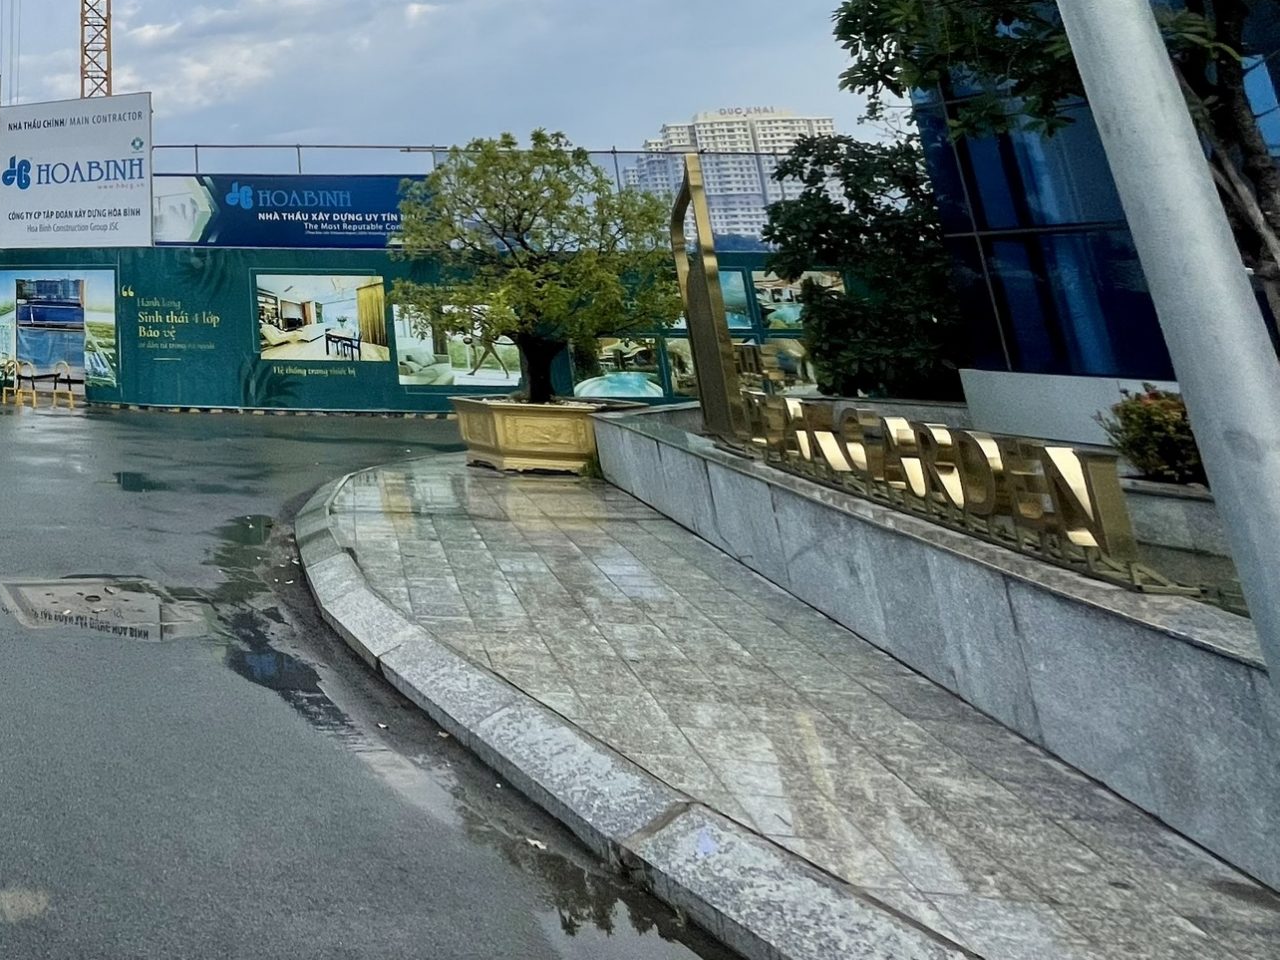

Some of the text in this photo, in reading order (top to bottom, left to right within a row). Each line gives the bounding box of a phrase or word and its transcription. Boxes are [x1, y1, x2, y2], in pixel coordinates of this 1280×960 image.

[8, 121, 23, 131] NHÀ
[23, 118, 42, 129] THẦU
[69, 116, 90, 126] MAIN
[92, 110, 143, 125] CONTRACTOR
[36, 158, 145, 185] HOABINH
[257, 190, 353, 207] HOABINH
[8, 207, 141, 221] CÔNG TY CP TẬP ĐOÀN XÂY DỰNG HÒA BÌNH
[258, 211, 280, 221] NHÀ
[281, 210, 309, 221] THẦU
[311, 211, 330, 221] XÂY
[333, 212, 363, 223] DỰNG
[365, 213, 378, 221] UY
[380, 212, 398, 221] TÍN
[27, 224, 38, 232] Hoa
[52, 223, 89, 232] Construction
[90, 222, 108, 233] Group
[109, 222, 119, 231] JSC
[304, 222, 319, 230] The
[320, 222, 340, 230] Most
[342, 223, 383, 232] Reputable
[137, 310, 163, 323] Sinh
[165, 310, 190, 324] thái
[202, 311, 220, 327] lớp
[138, 325, 177, 341] Bảo vệ
